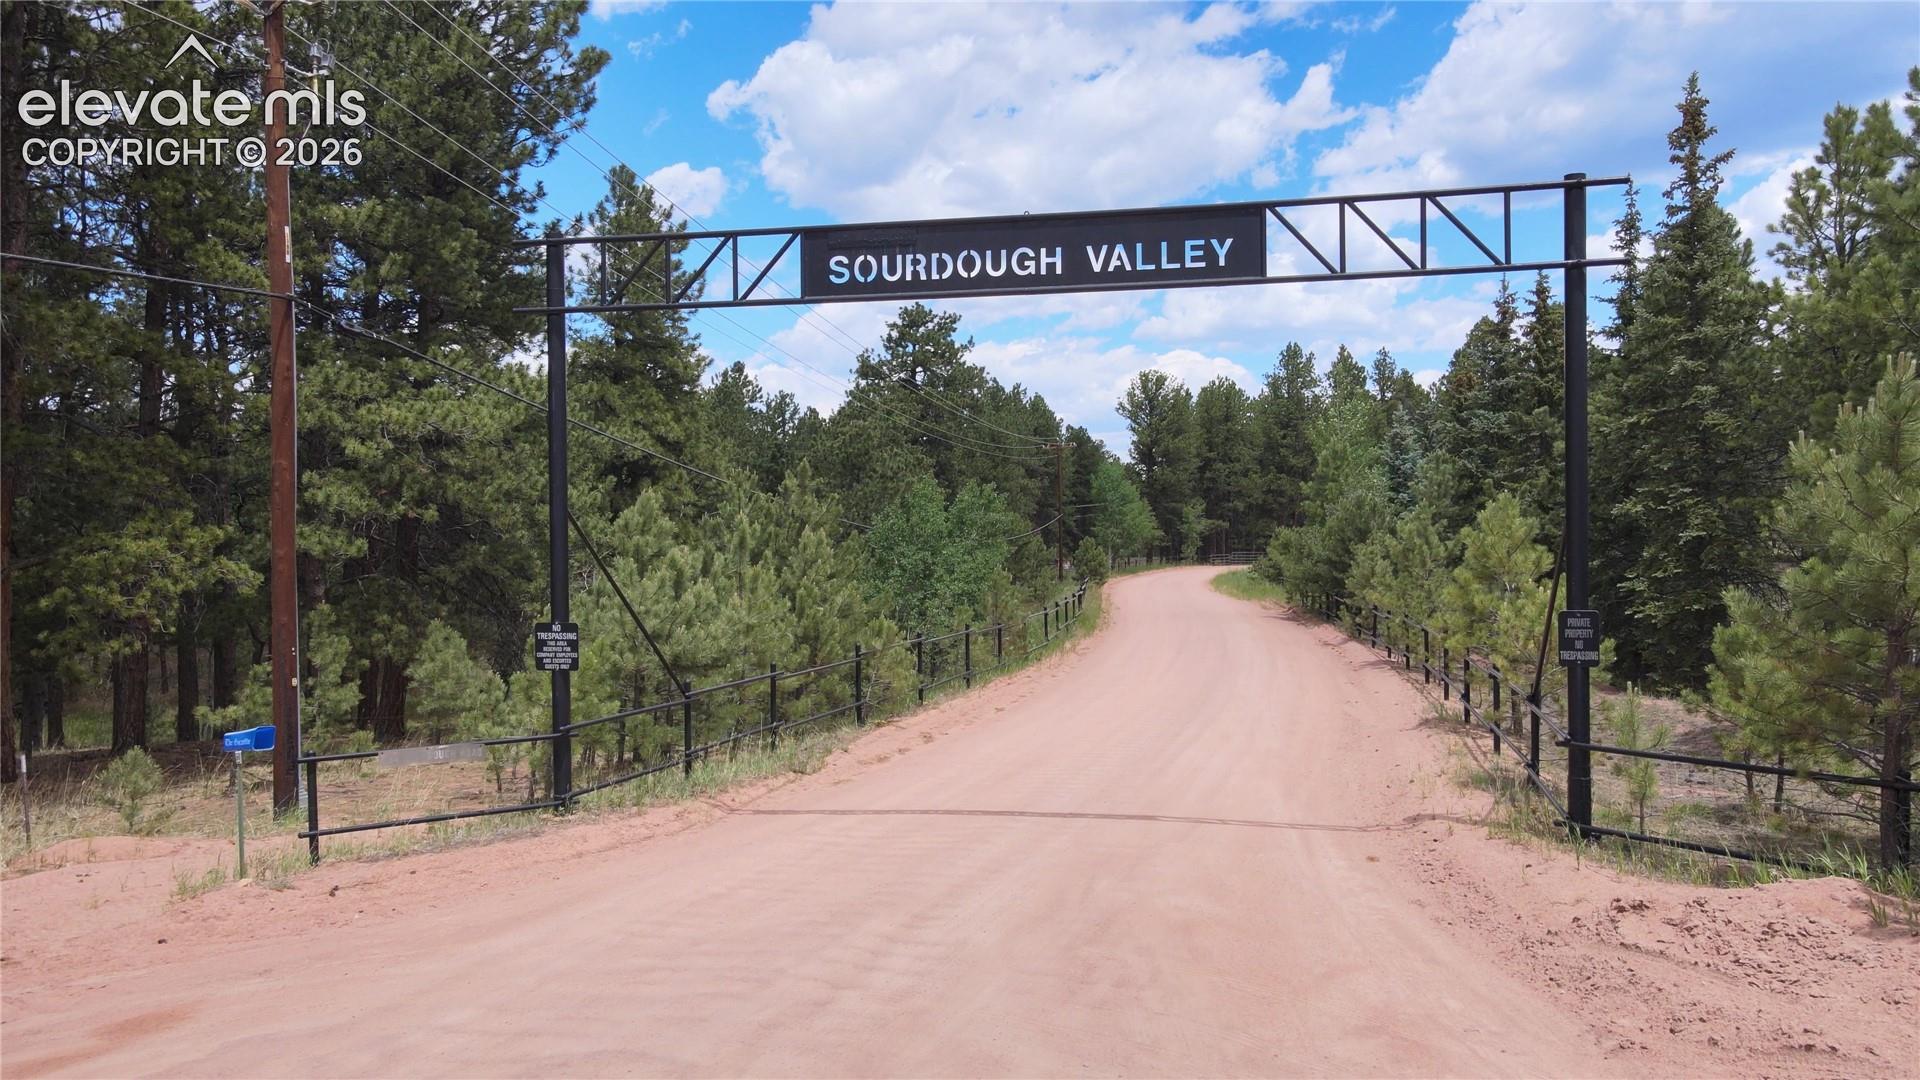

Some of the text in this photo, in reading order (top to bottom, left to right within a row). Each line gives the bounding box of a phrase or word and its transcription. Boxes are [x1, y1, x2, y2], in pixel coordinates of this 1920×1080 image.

[828, 238, 1234, 285] SOURDOUGH VALLEY
[1567, 618, 1591, 627] PRIVATE
[552, 624, 561, 632] NO
[537, 632, 577, 640] TRESPASSING
[1564, 629, 1594, 638] PROPERTY
[1574, 640, 1584, 649] NO
[1560, 651, 1599, 660] TRESPASSING
